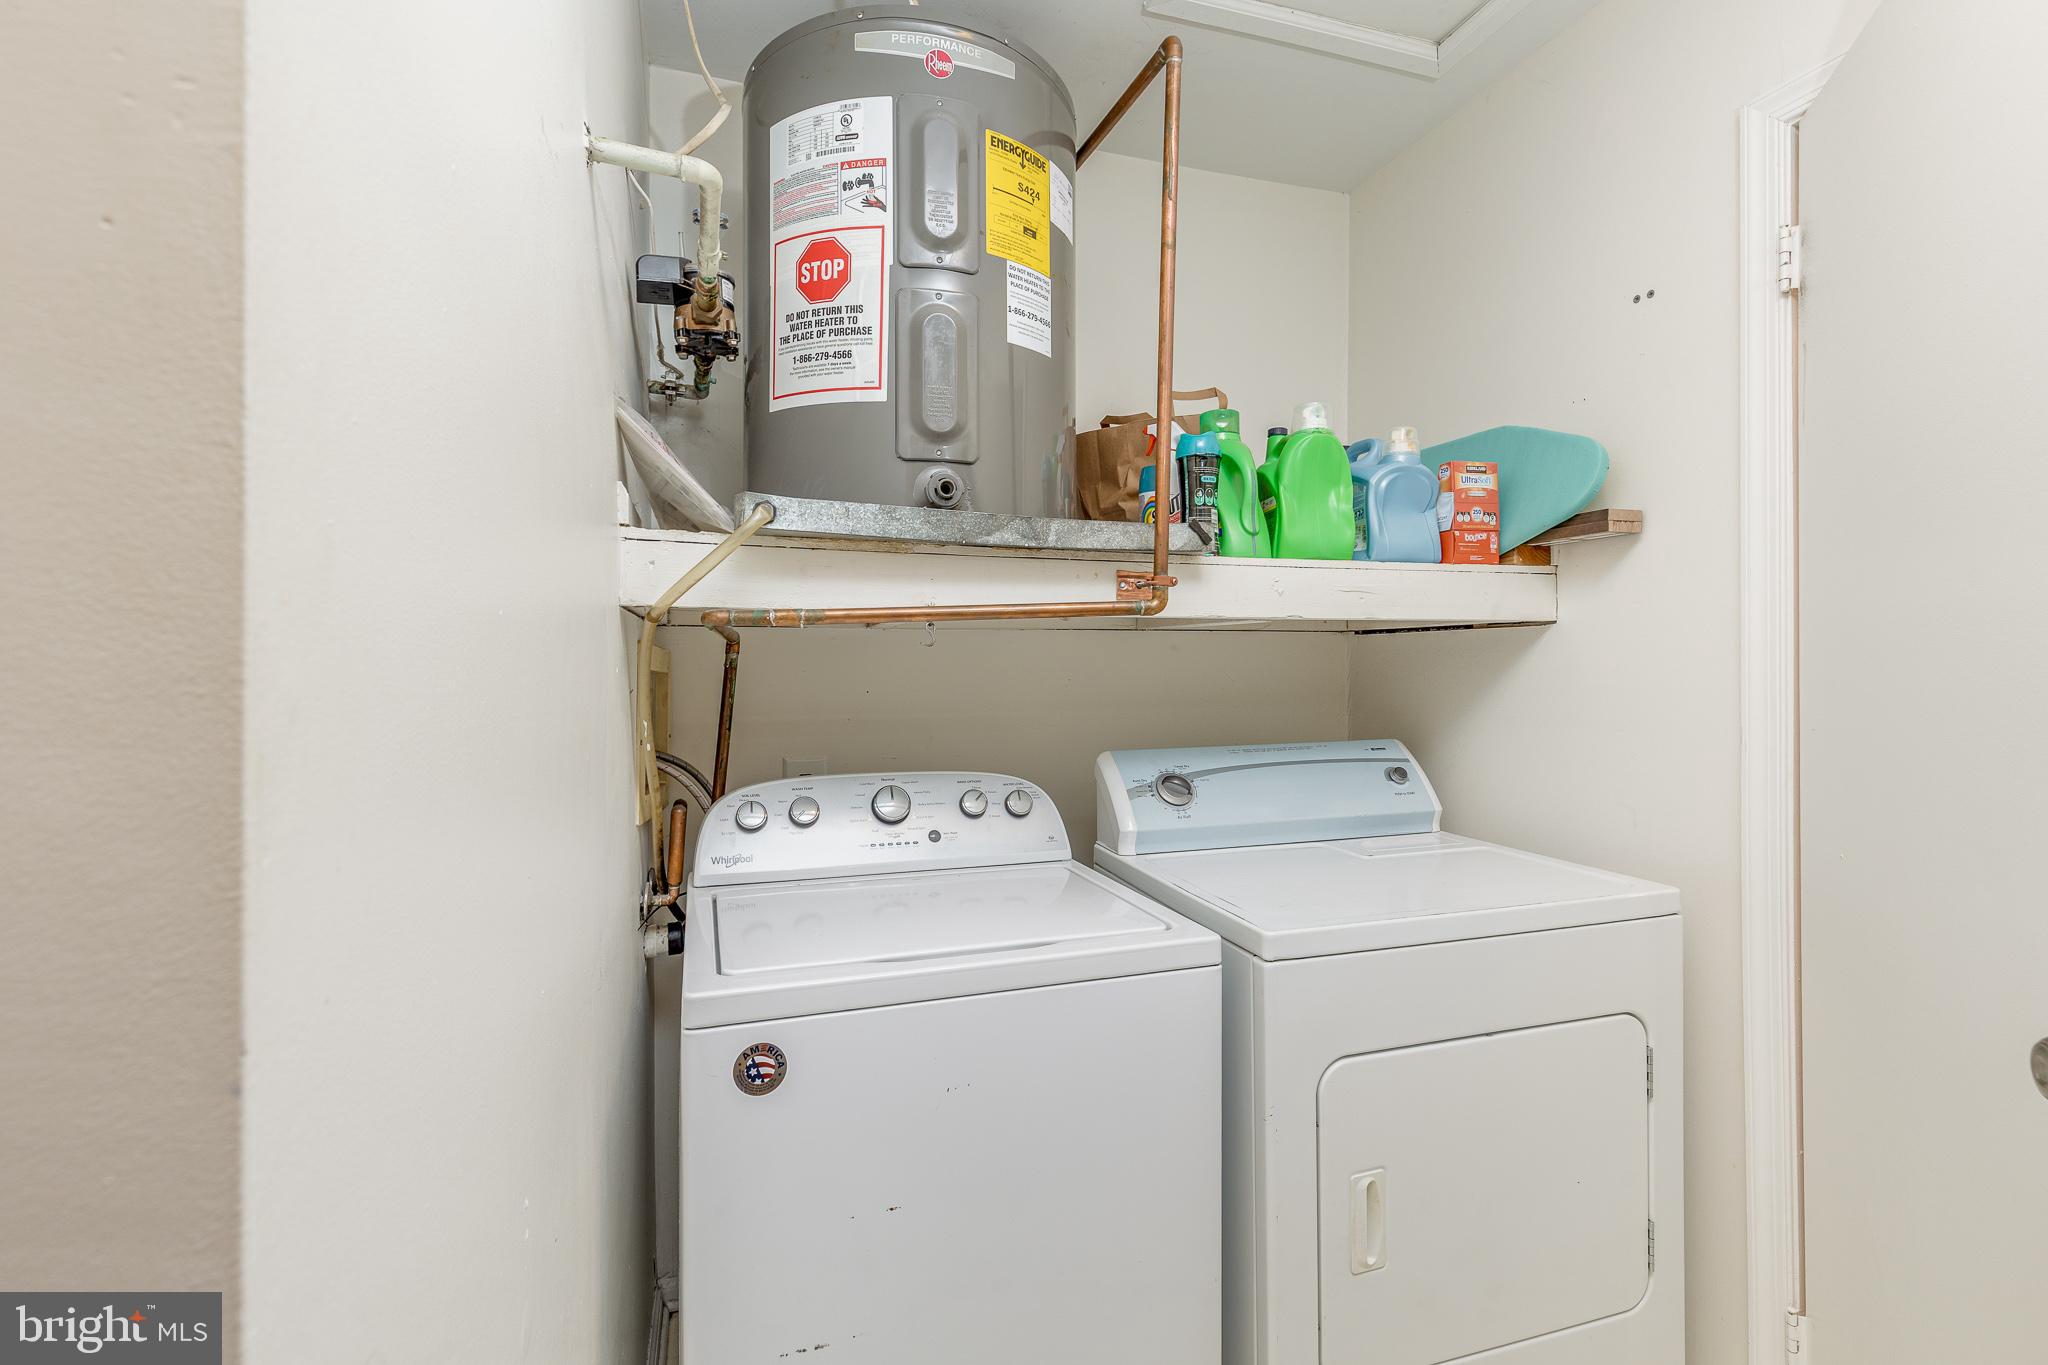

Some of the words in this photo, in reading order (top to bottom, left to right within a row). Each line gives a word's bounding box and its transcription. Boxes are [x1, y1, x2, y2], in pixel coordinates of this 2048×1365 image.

[891, 33, 982, 58] PERFORMANCE
[927, 49, 954, 74] Rheem
[851, 159, 884, 168] DANGER
[990, 135, 1047, 174] ENERGYGUIDE
[801, 258, 845, 284] STOP
[1008, 272, 1024, 282] WATER
[1024, 276, 1039, 288] HEATER
[1009, 264, 1017, 272] DO
[1017, 266, 1027, 275] NOT
[1026, 269, 1042, 282] RETURN
[1010, 281, 1024, 291] PLACE
[1024, 285, 1030, 293] OF
[785, 313, 795, 323] DO
[796, 309, 810, 321] NOT
[811, 306, 842, 318] RETURN
[844, 304, 864, 314] THIS
[1008, 305, 1051, 328] 1-866-279-4566
[789, 319, 813, 332] WATER
[814, 316, 845, 329] HEATER
[847, 316, 858, 325] TO
[780, 335, 791, 346] THE
[792, 330, 814, 342] PLACE
[816, 329, 826, 339] OF
[828, 326, 873, 337] PURCHASE
[792, 349, 853, 365] 1-866-279-4566
[710, 853, 753, 868] Whirlpool
[742, 1044, 785, 1069] AMERICA
